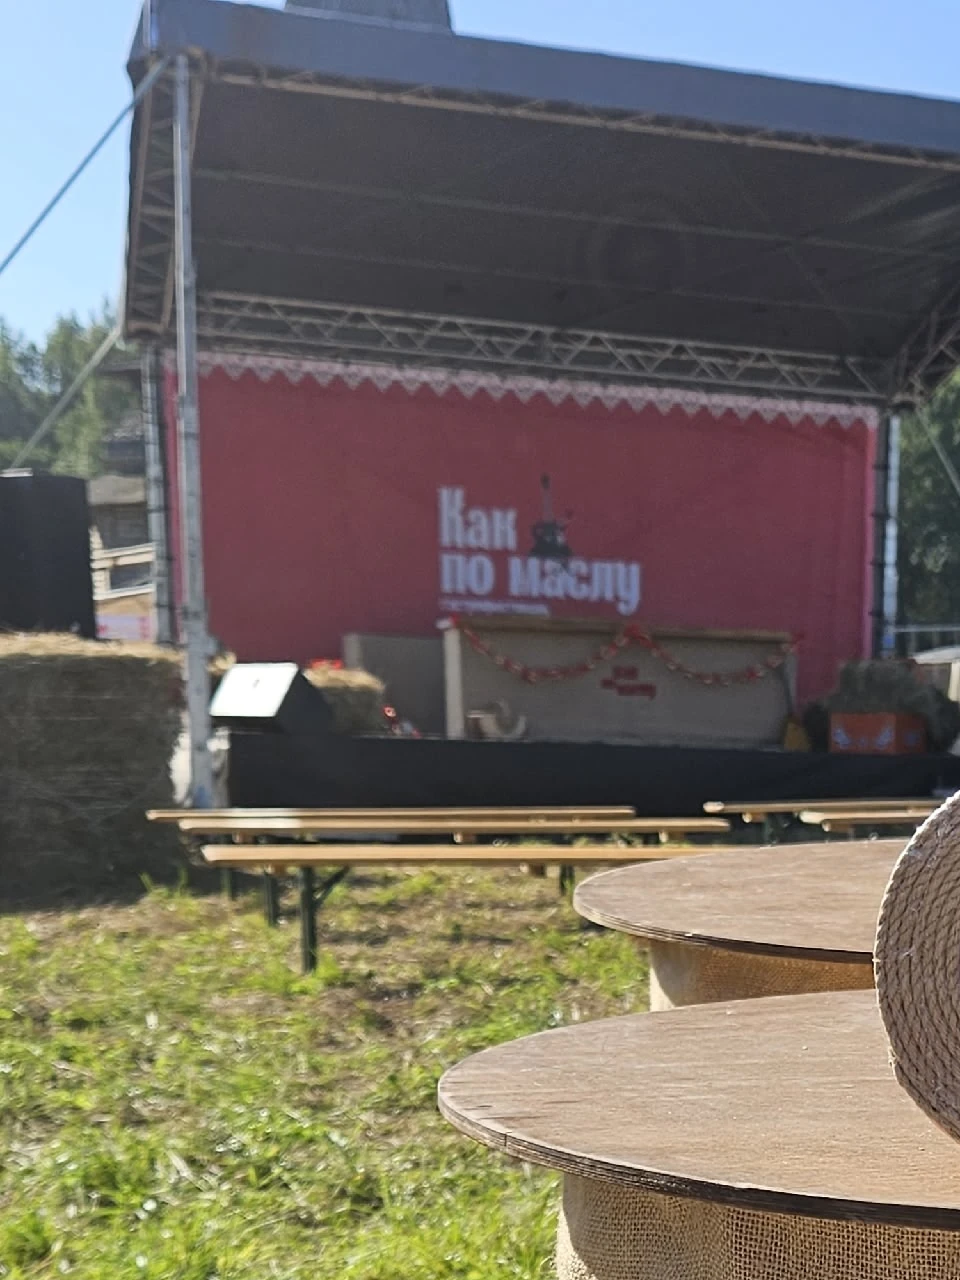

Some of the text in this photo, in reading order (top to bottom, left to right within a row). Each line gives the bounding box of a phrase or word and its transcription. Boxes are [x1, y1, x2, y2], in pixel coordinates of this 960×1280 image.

[438, 487, 518, 550] Как
[439, 552, 642, 617] по маслу
